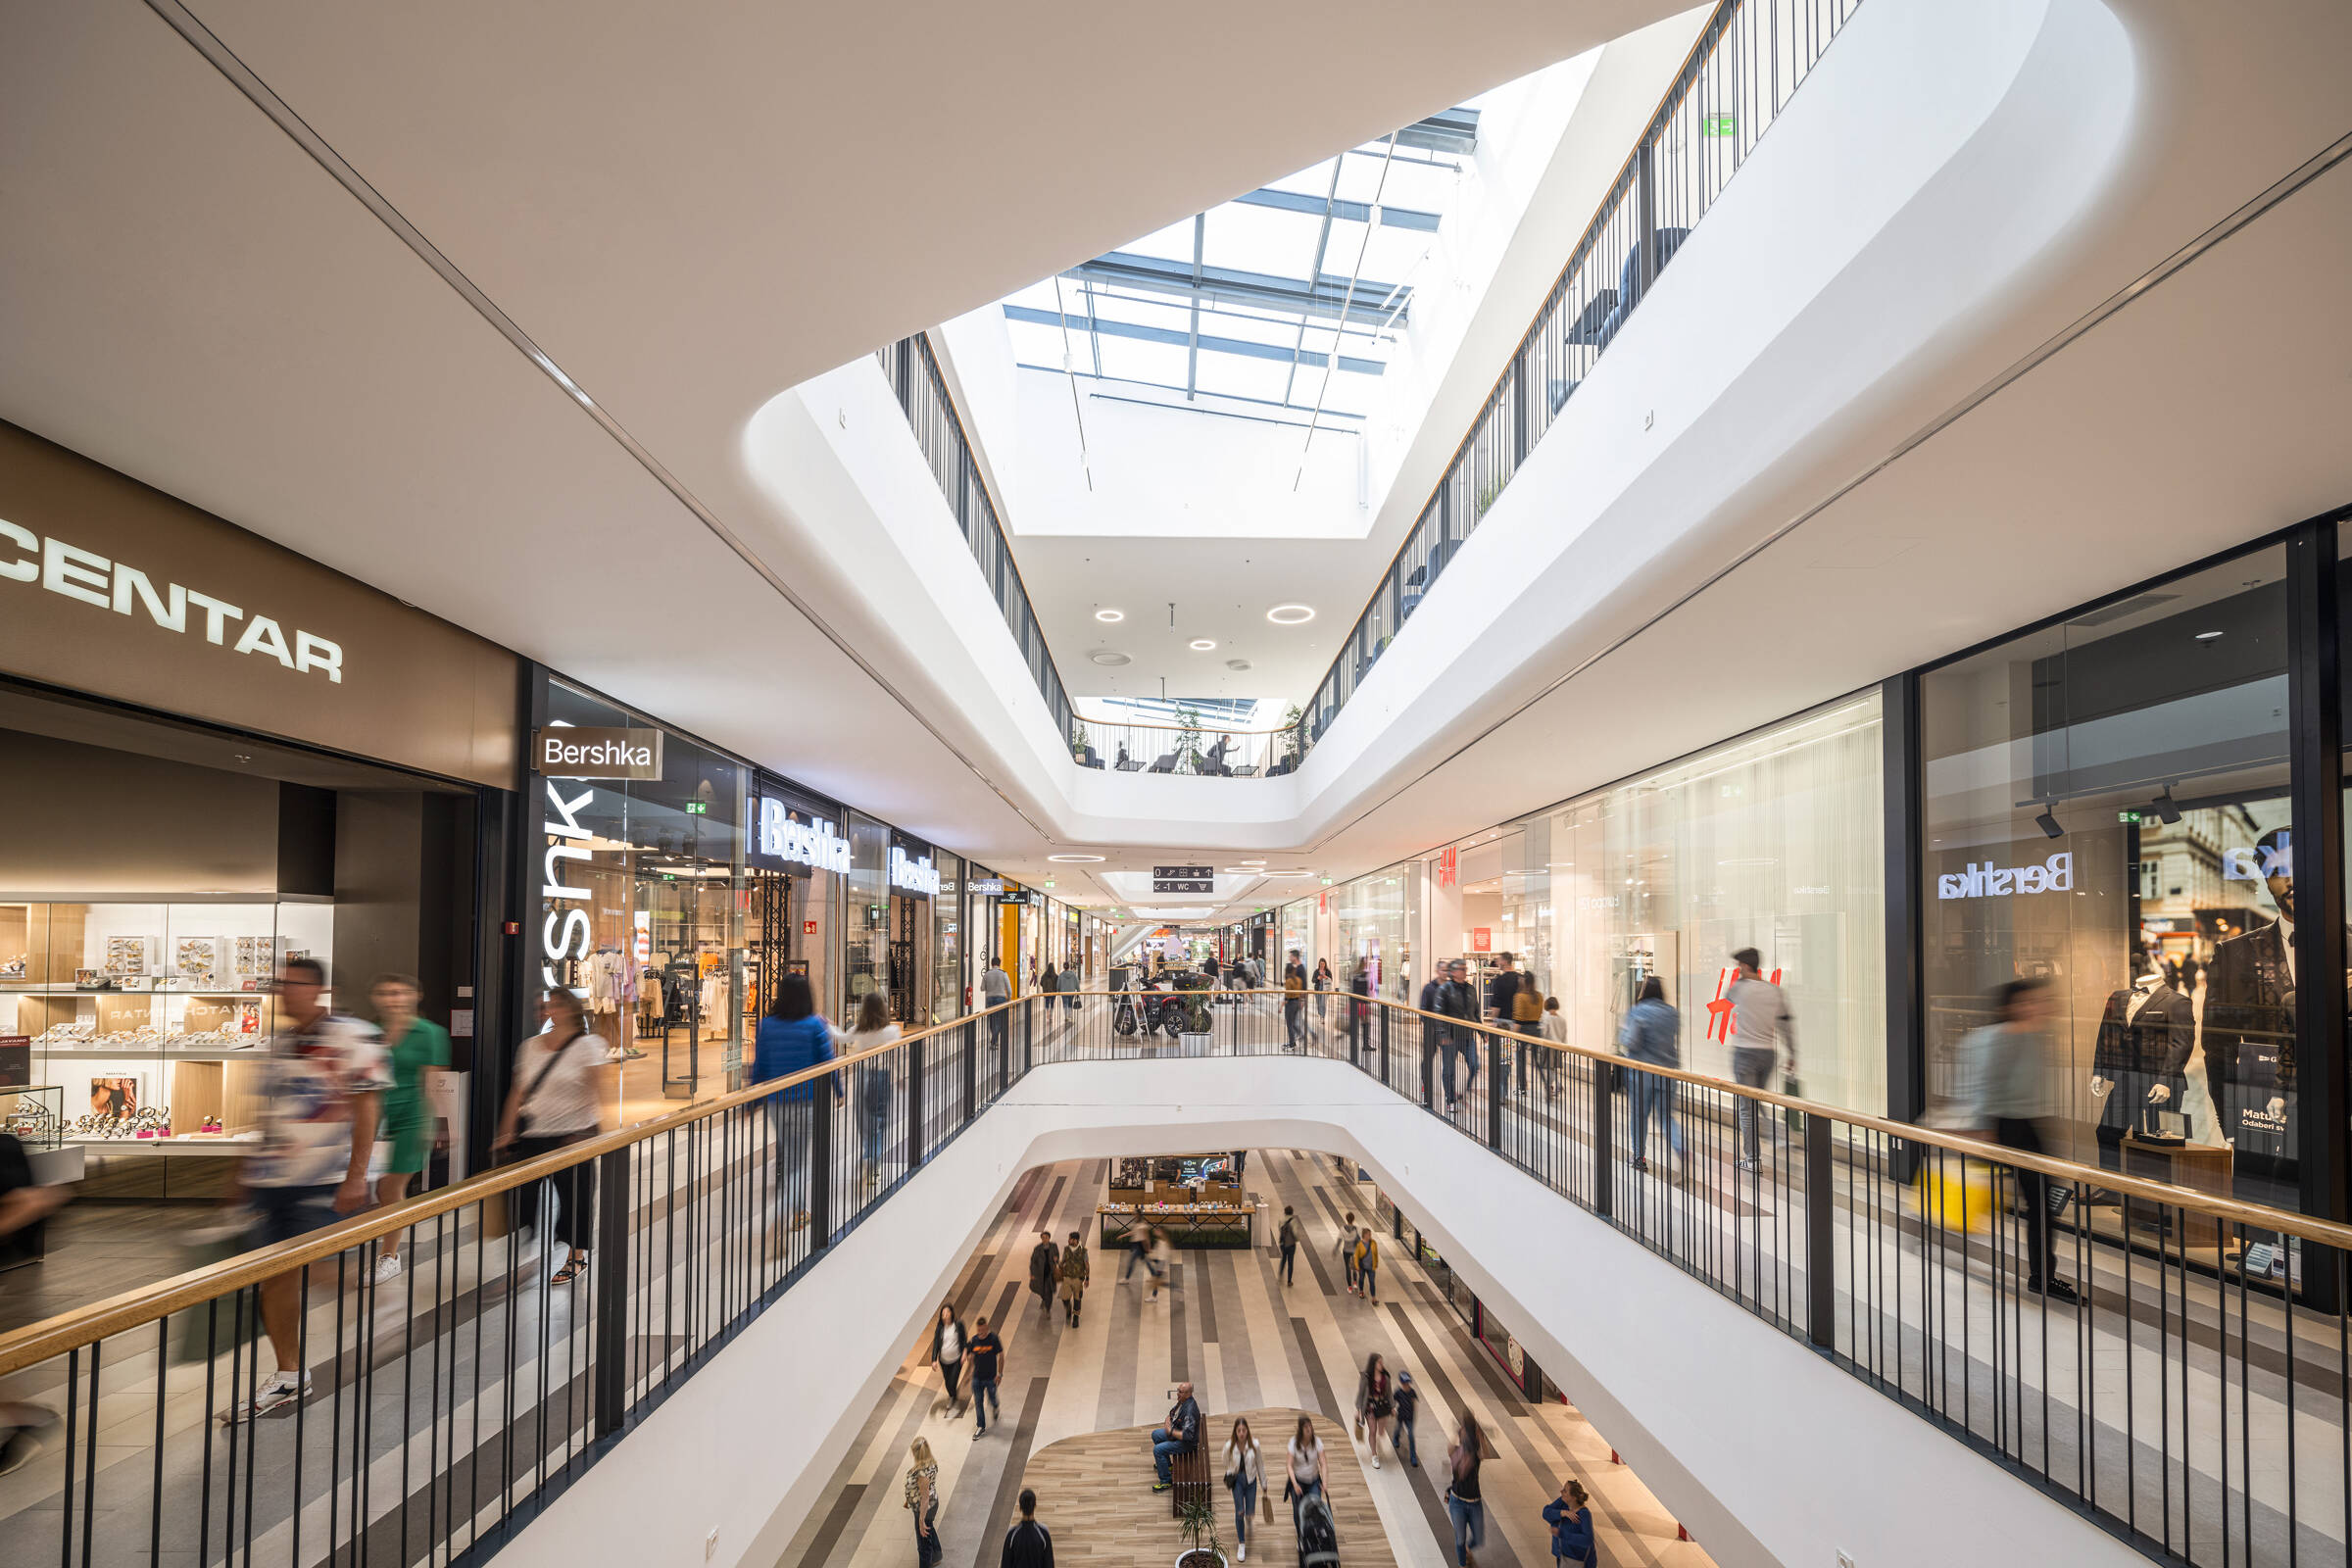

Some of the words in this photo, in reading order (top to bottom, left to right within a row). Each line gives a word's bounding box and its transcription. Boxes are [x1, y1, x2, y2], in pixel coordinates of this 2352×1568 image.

[0, 518, 343, 684] CENTAR
[545, 738, 651, 766] Bershka
[760, 797, 851, 874] Bershka
[890, 847, 941, 895] Bershka
[967, 882, 1003, 892] Bershka
